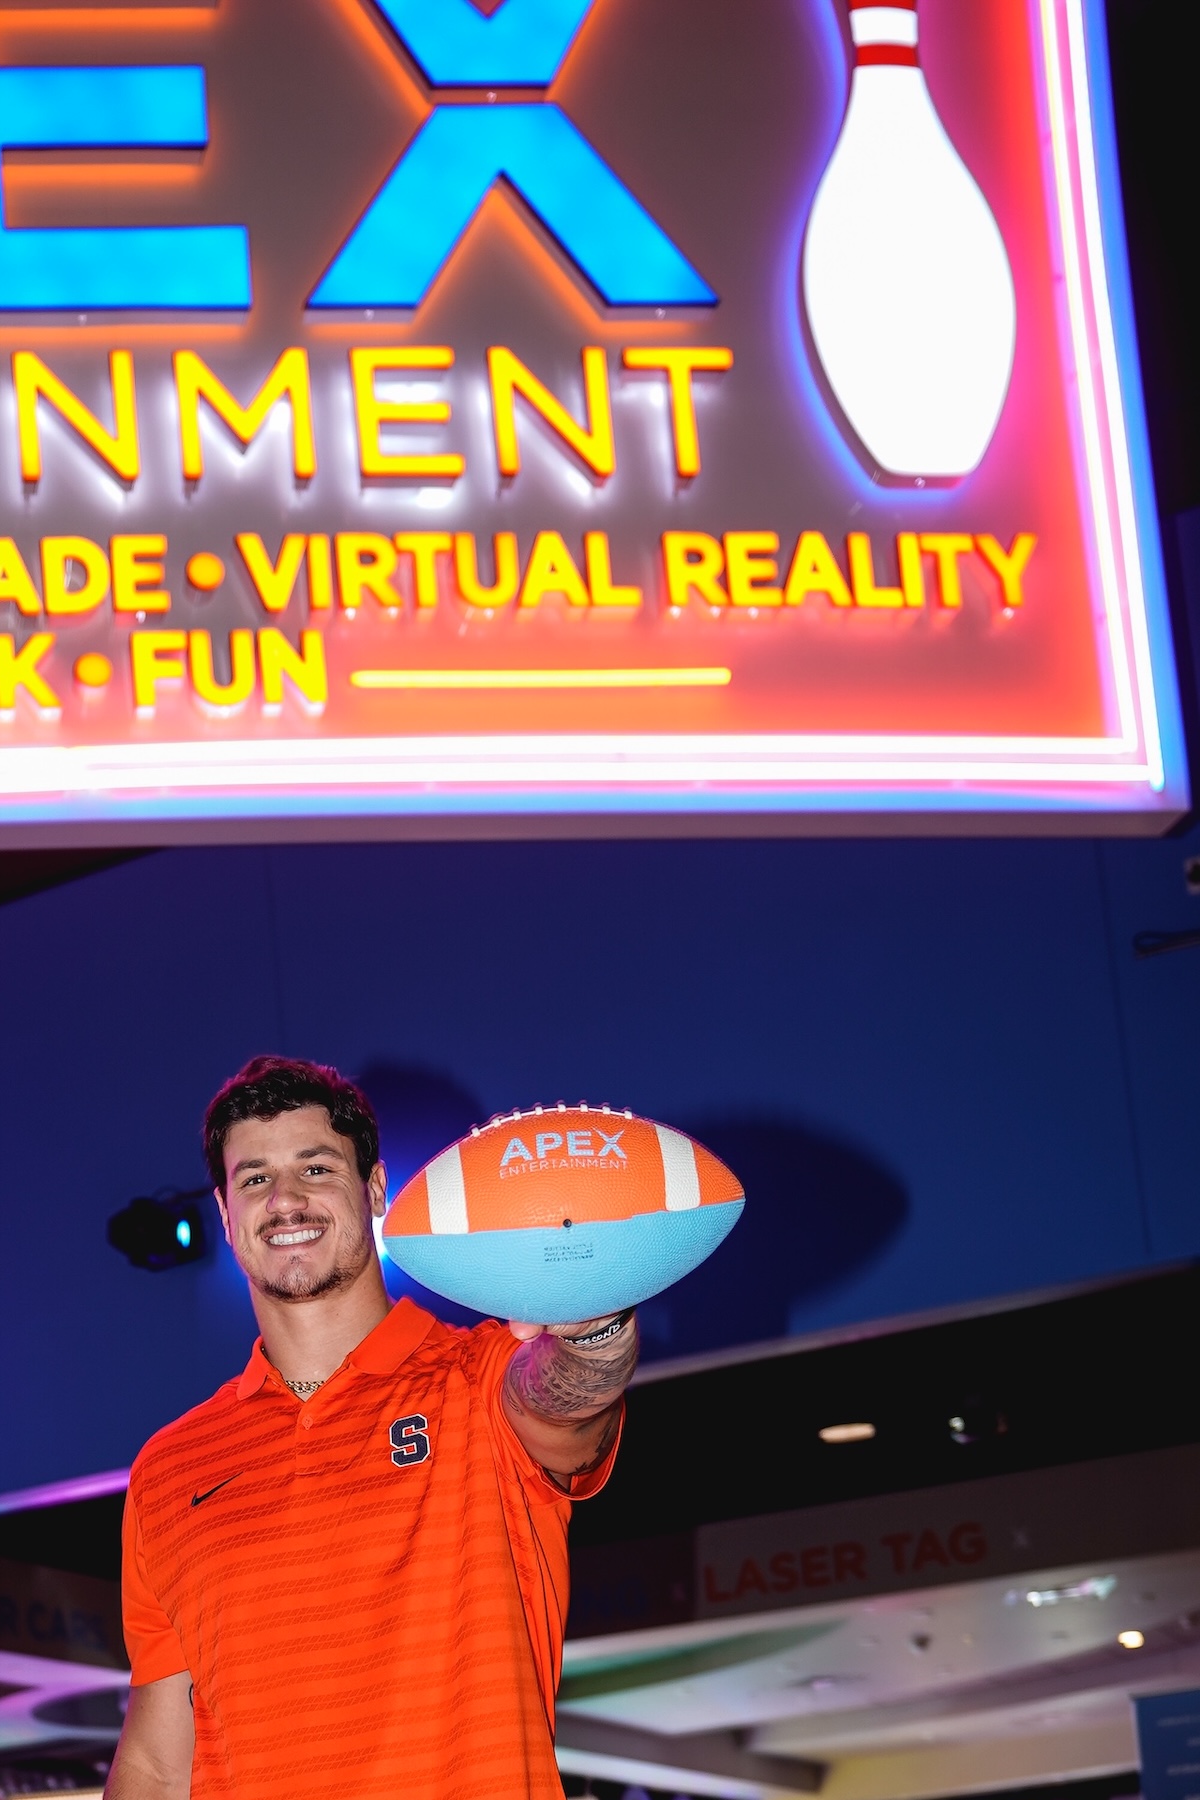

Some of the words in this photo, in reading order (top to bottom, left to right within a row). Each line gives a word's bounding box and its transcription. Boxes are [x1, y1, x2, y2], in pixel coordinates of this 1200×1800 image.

[236, 531, 642, 611] VIRTUAL
[663, 532, 1038, 609] REALITY
[130, 629, 328, 708] FUN
[499, 1158, 628, 1180] ENTERTAINMENT
[500, 1126, 628, 1168] APEX
[389, 1413, 431, 1467] S
[703, 1541, 870, 1603] LASER
[881, 1522, 988, 1574] TAG
